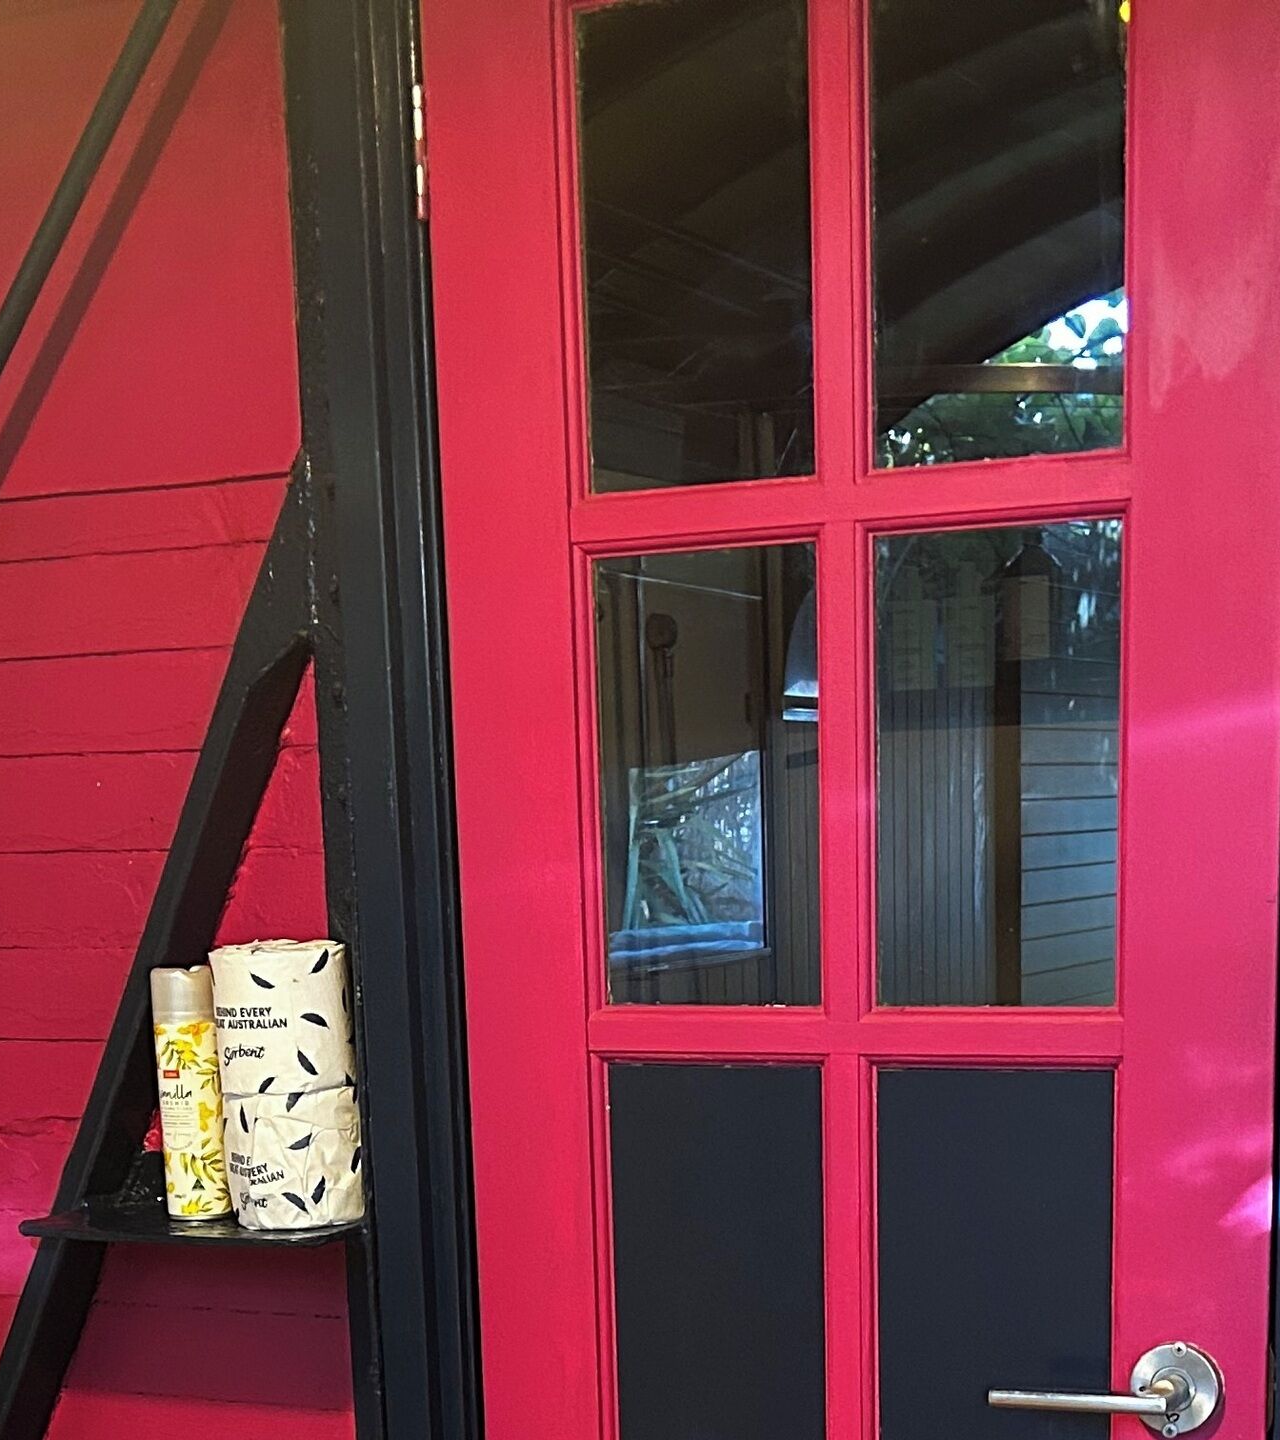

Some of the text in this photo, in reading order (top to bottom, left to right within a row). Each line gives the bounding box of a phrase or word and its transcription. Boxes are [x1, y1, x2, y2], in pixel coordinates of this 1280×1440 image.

[240, 1007, 272, 1017] EVERY
[228, 1018, 288, 1030] AUSTRALIAN
[224, 1043, 265, 1067] Sorbent
